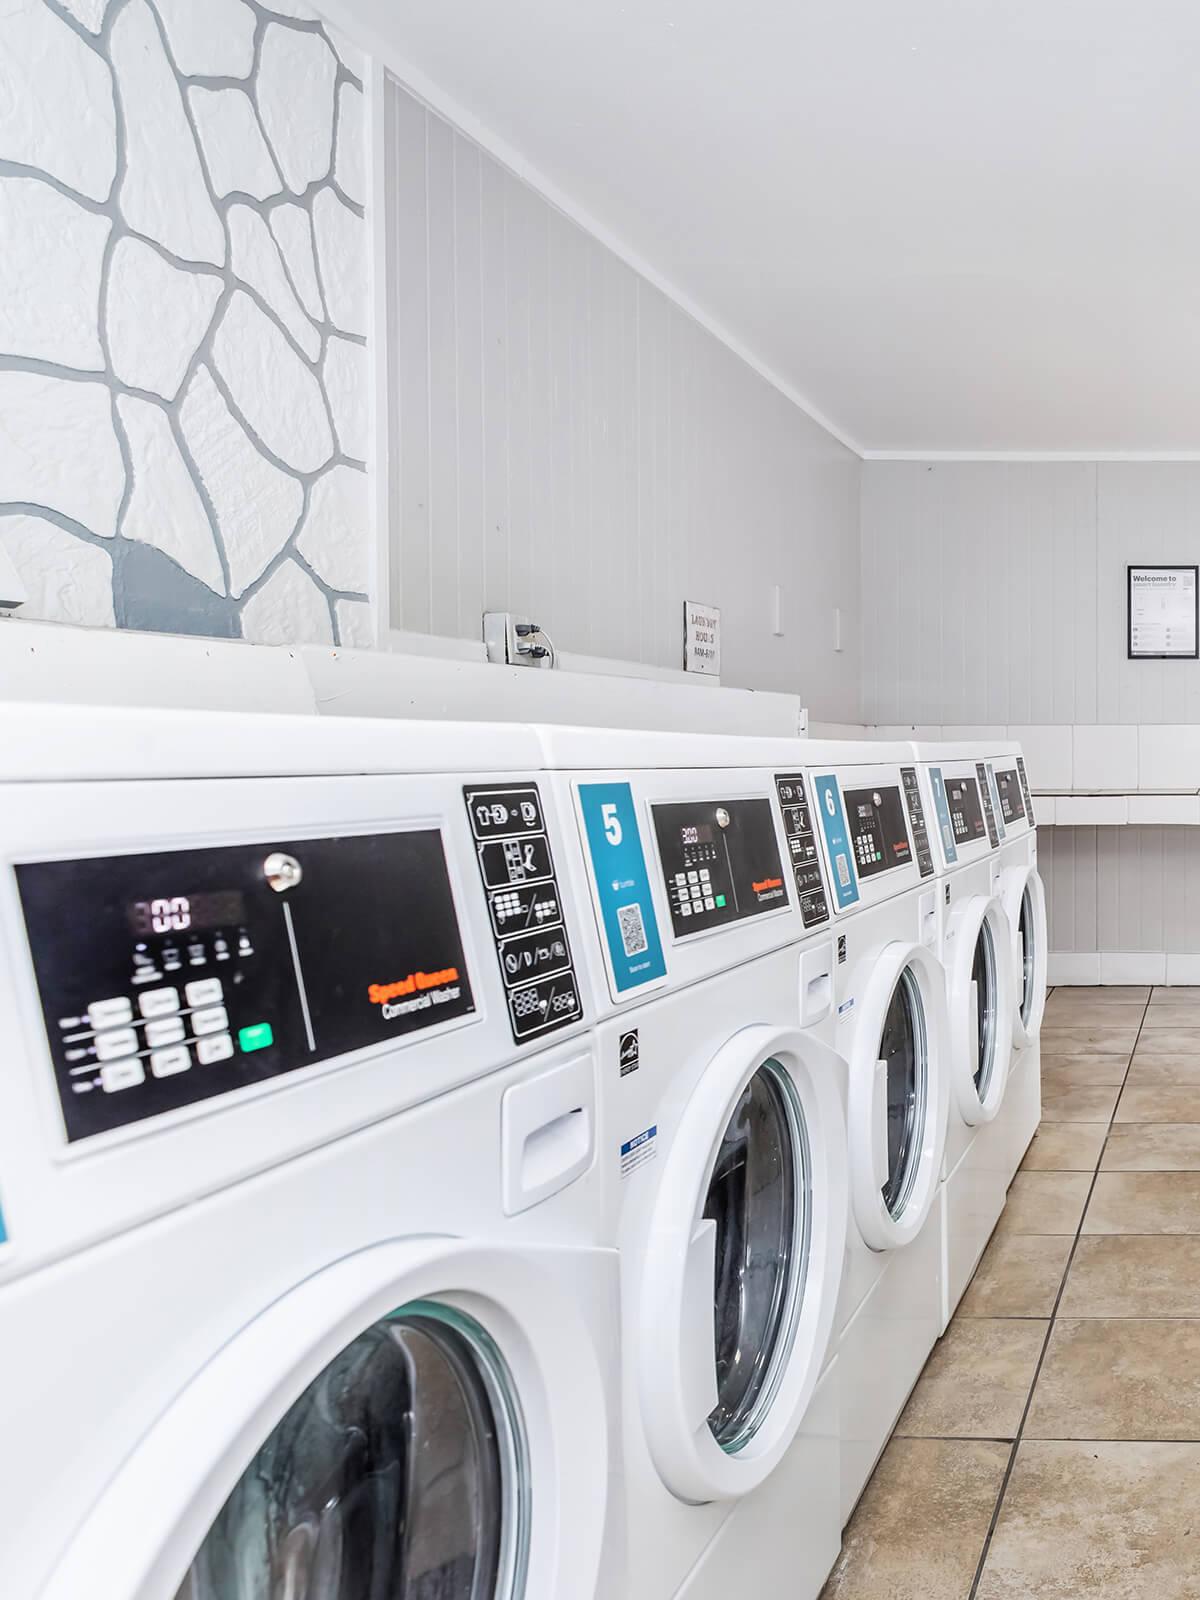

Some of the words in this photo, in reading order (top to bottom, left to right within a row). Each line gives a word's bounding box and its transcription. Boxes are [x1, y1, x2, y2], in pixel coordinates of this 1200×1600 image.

[695, 631, 714, 644] HOUS
[825, 788, 836, 816] 6
[601, 803, 623, 847] 5
[368, 974, 416, 1004] Speed
[415, 967, 459, 990] Queen
